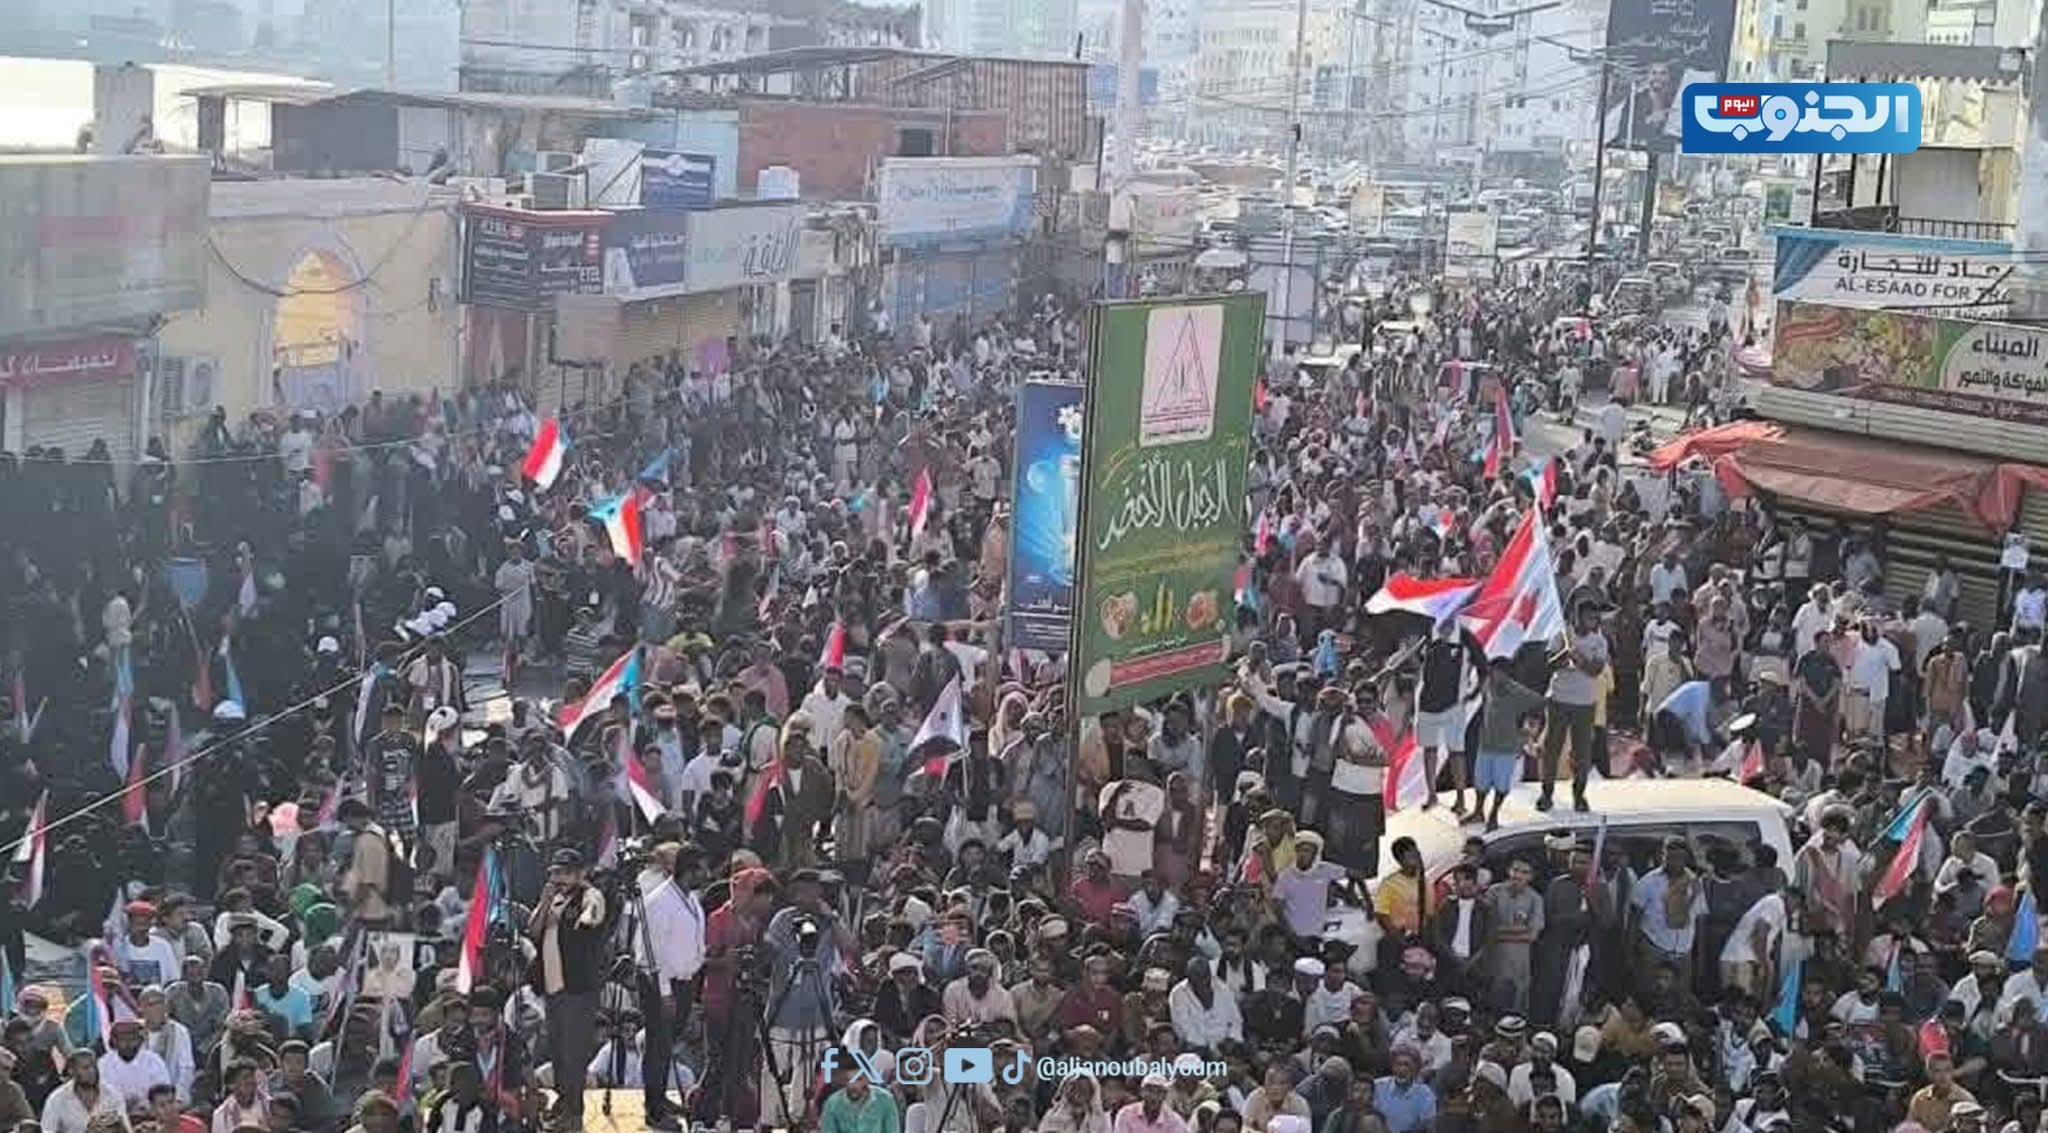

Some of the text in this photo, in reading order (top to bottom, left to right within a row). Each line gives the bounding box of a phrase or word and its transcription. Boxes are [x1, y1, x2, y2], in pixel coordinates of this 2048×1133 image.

[1837, 249, 1941, 277] للتجارة
[1835, 277, 1928, 297] AL-ESAAD
[1932, 284, 1970, 300] FOR
[1971, 331, 2039, 361] الميناء
[1957, 368, 2001, 392] والتمور
